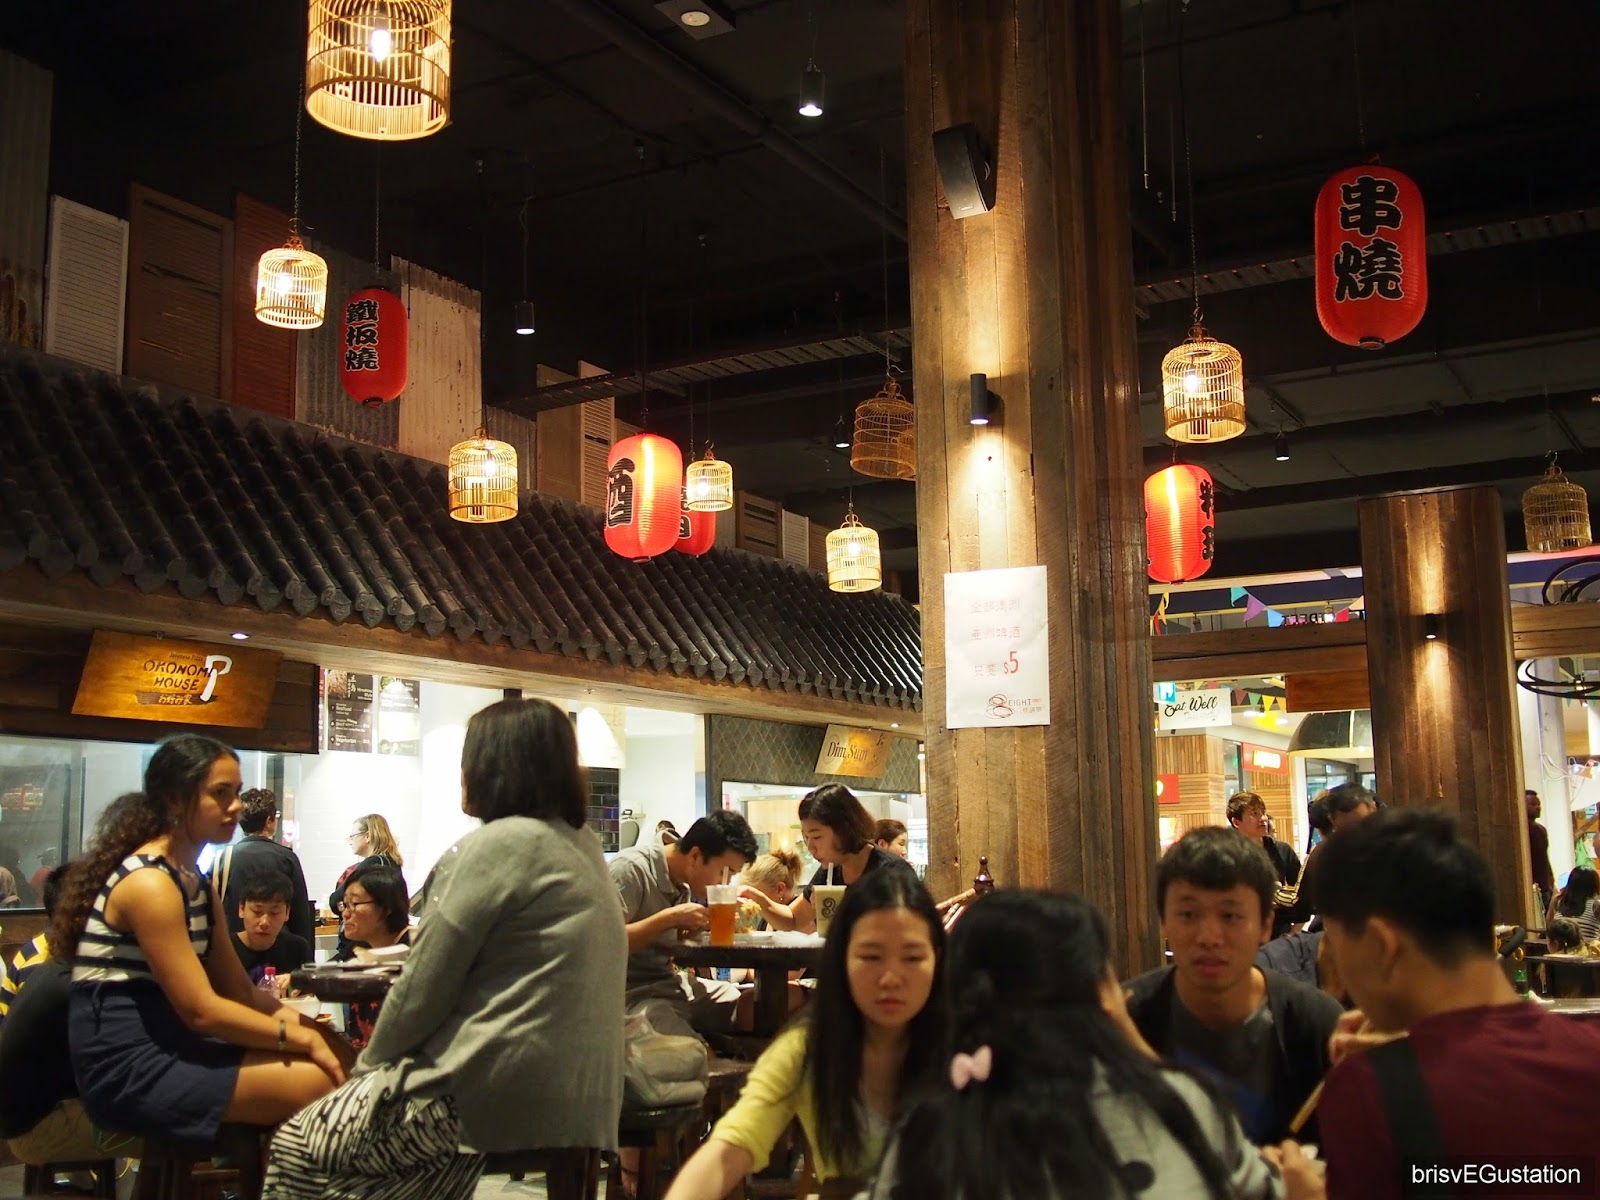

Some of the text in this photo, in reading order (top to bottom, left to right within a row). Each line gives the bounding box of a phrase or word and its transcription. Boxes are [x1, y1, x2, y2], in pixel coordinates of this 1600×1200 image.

[1333, 175, 1404, 303] 串燒
[143, 660, 214, 678] OKONOMI
[1003, 650, 1019, 675] $5
[154, 677, 200, 691] HOUSE
[1164, 700, 1187, 718] Eat
[1189, 695, 1218, 712] Well
[828, 741, 847, 758] Dim
[848, 744, 868, 761] Sum
